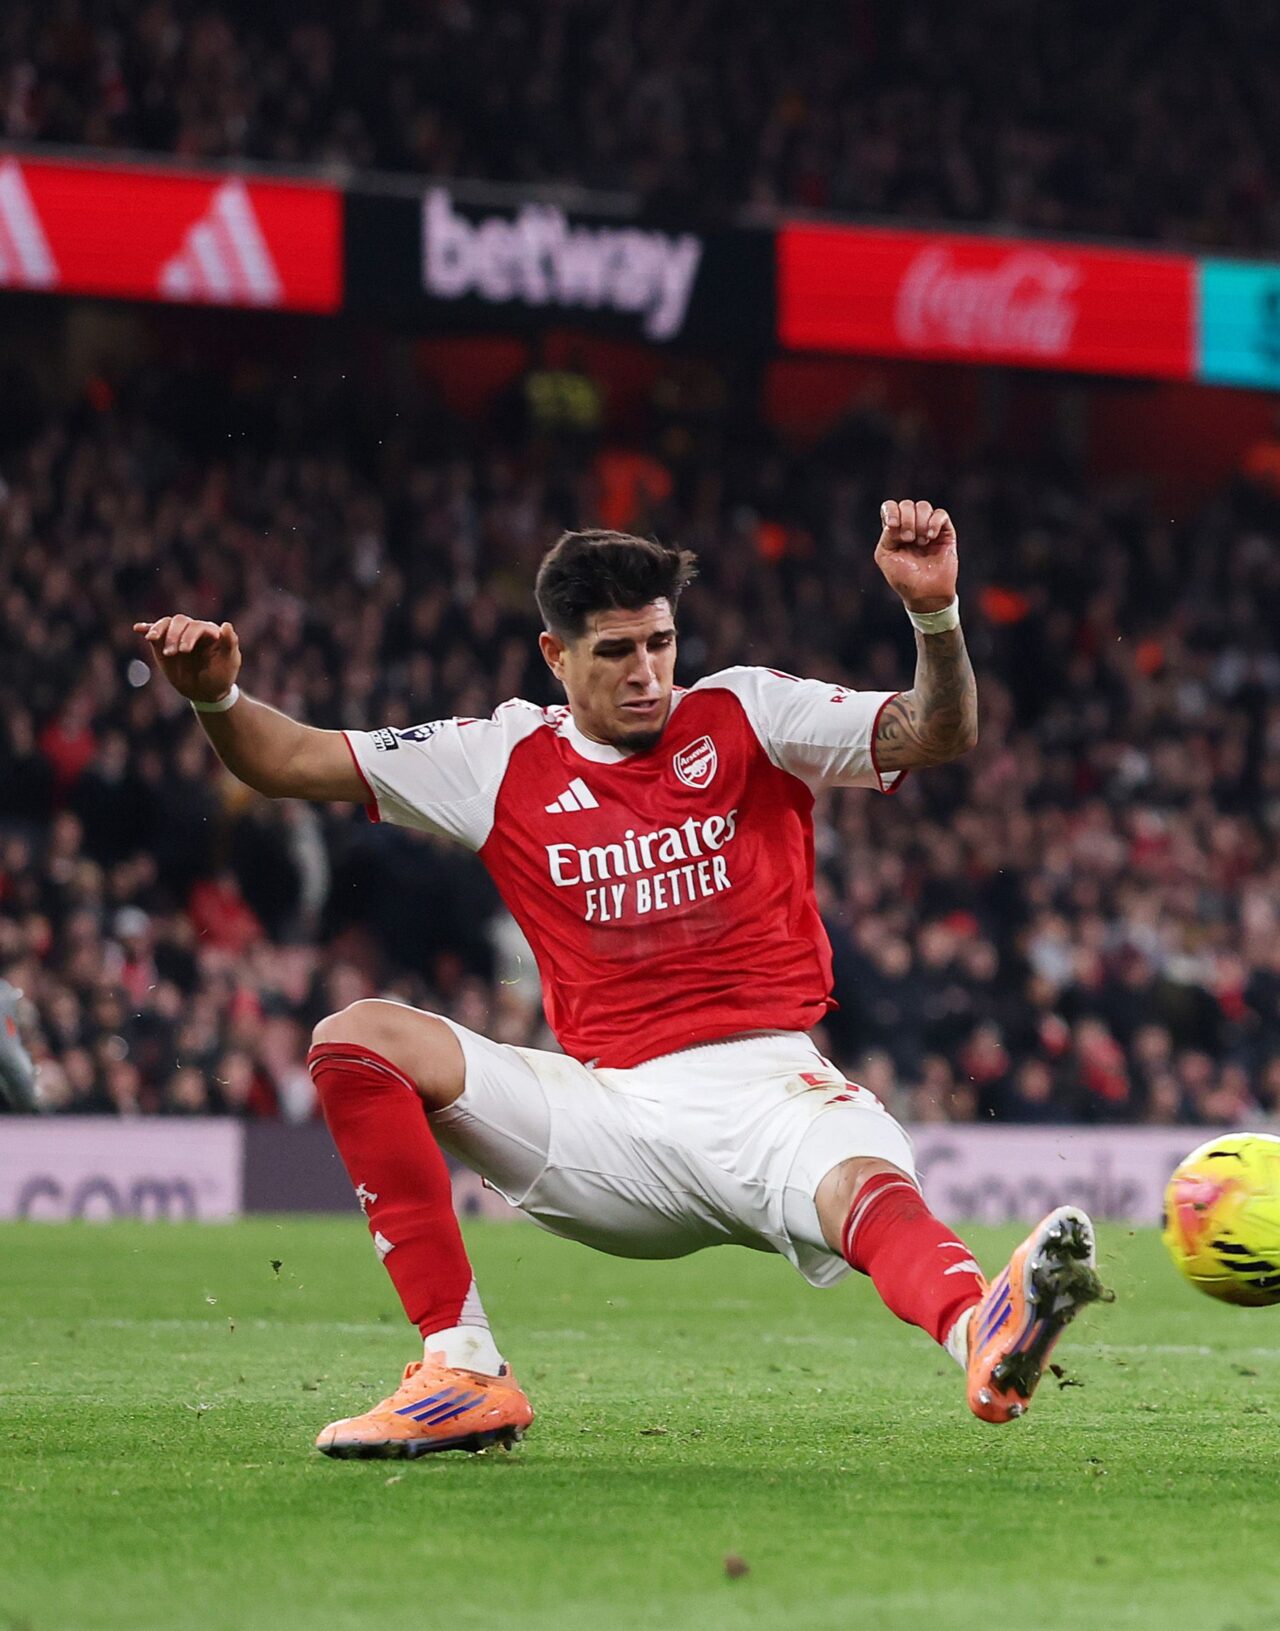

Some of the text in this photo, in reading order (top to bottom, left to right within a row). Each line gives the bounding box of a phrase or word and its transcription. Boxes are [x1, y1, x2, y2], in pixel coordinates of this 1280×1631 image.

[422, 188, 700, 340] betway
[680, 742, 709, 766] Arsenal
[545, 809, 738, 887] Emirates
[585, 855, 732, 922] FLY BETTER
